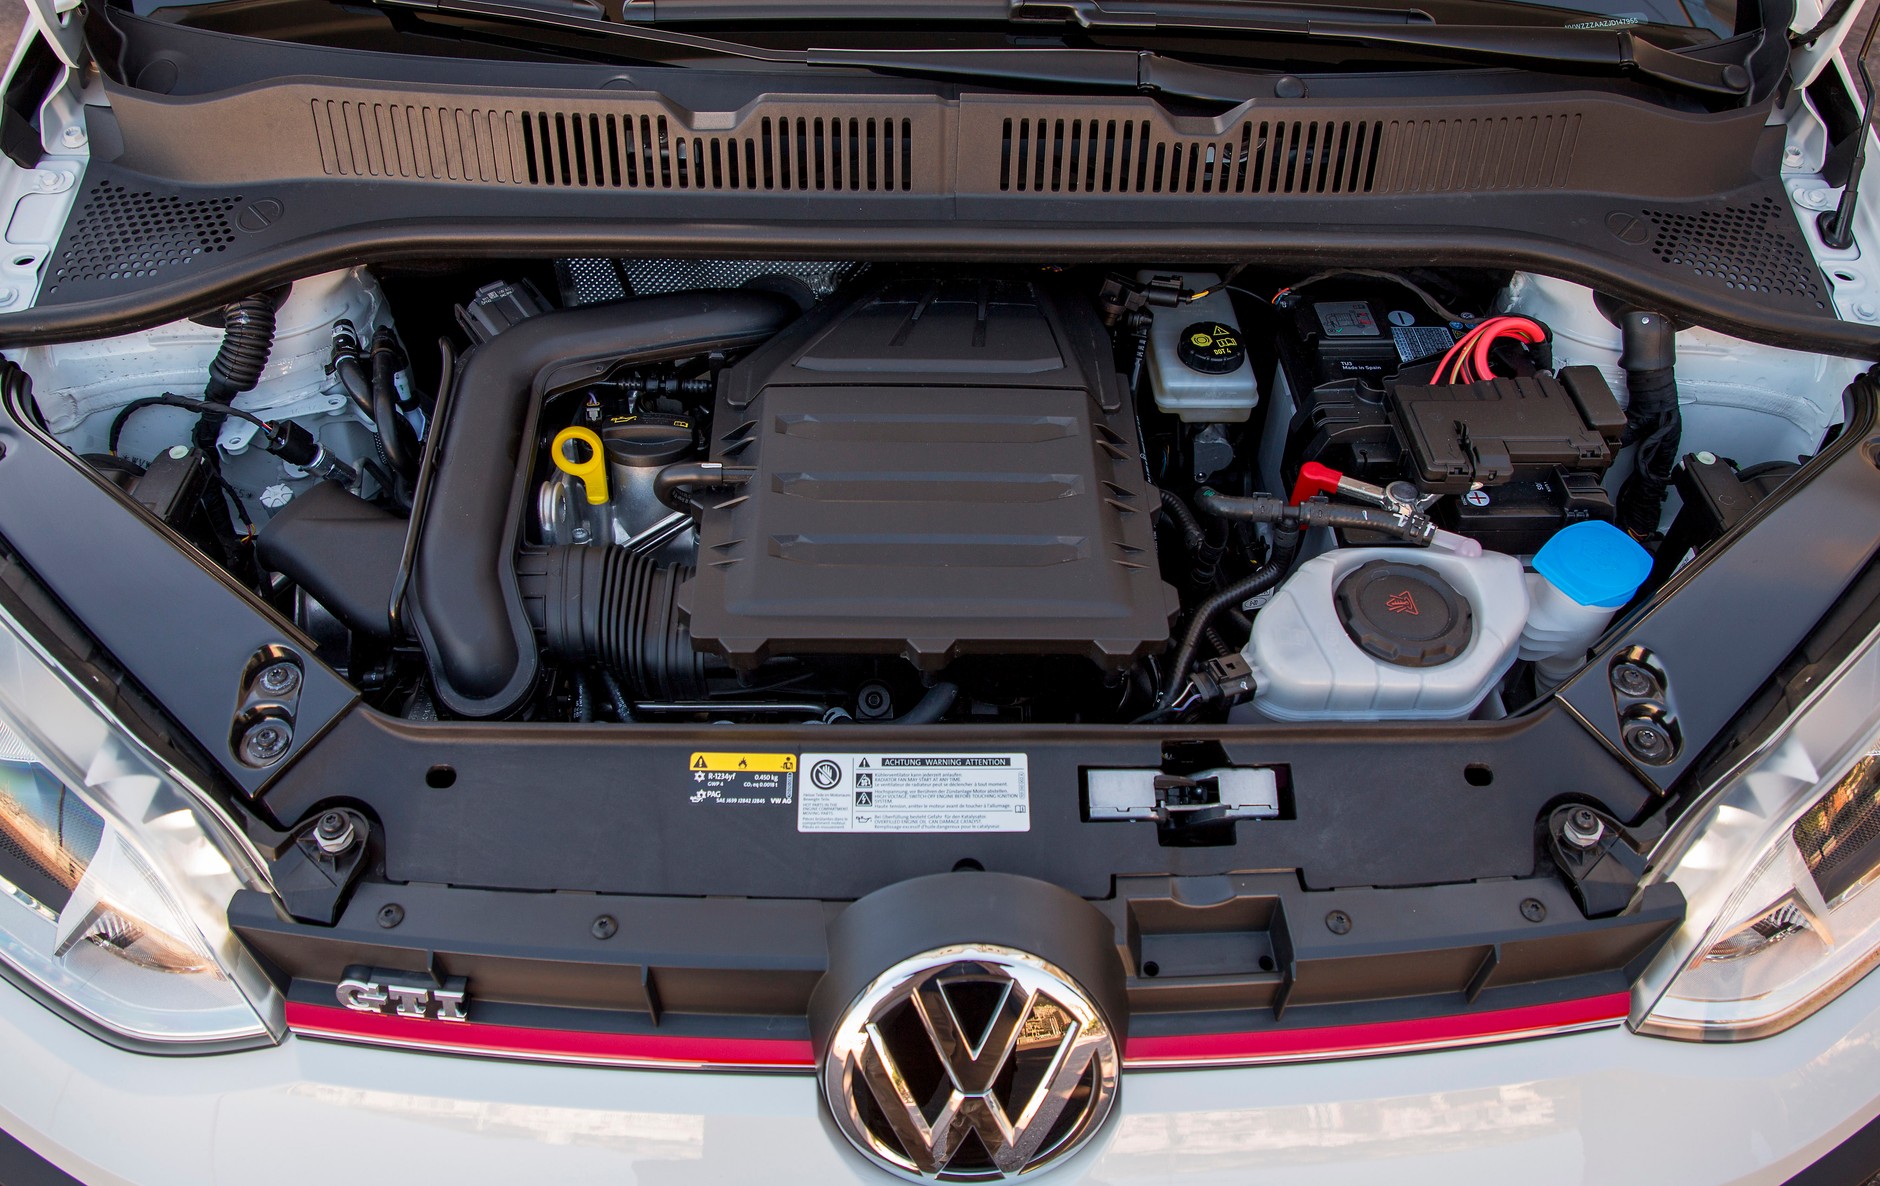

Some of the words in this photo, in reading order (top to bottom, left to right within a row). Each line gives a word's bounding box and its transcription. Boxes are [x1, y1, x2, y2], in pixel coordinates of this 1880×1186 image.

[884, 758, 921, 766] ACHTUNG
[925, 758, 961, 766] WARNING
[965, 758, 1006, 766] ATTENTION
[708, 772, 736, 782] R-1234yf
[771, 774, 779, 782] kg
[707, 790, 721, 798] PAG
[335, 979, 468, 1022] GTI
